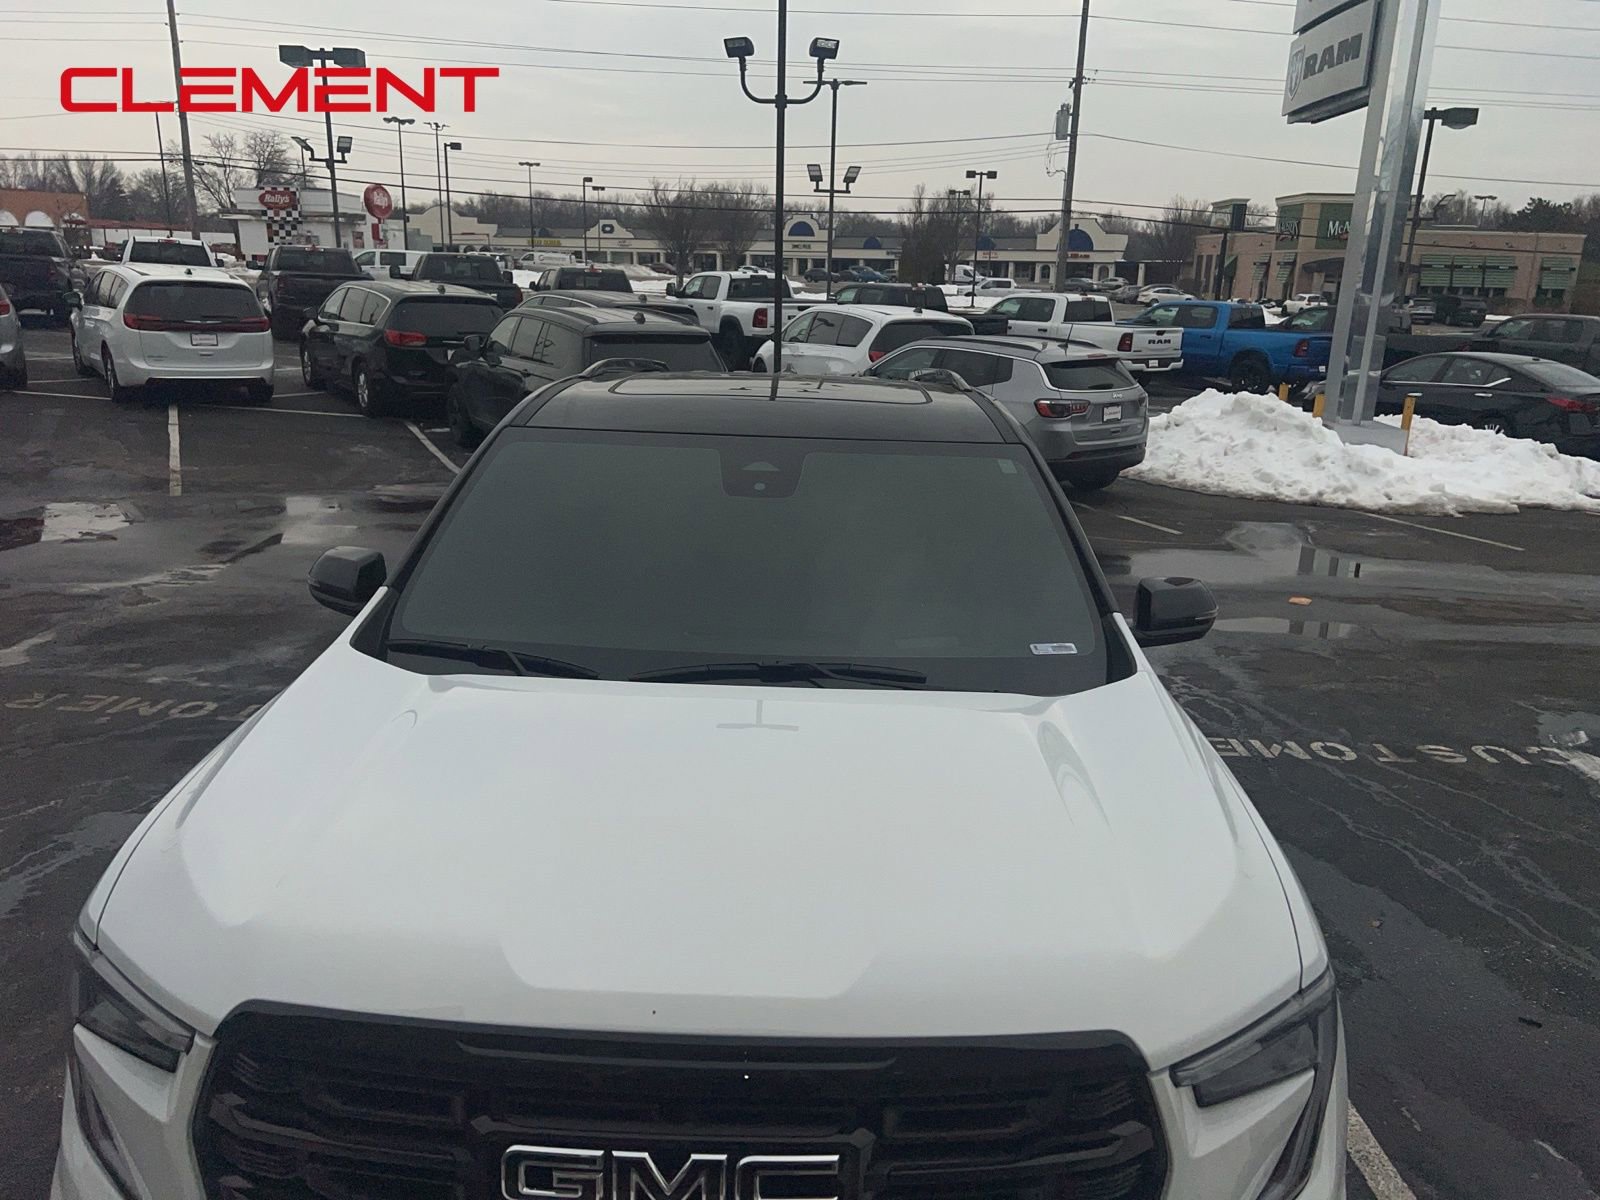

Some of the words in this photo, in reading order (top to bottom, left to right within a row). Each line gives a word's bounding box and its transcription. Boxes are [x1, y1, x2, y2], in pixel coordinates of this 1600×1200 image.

[1303, 32, 1363, 80] RAM
[264, 194, 290, 203] Rally's
[1327, 220, 1351, 238] McA
[4, 693, 262, 721] TOMER
[1208, 737, 1571, 765] CUSTOME
[501, 1144, 840, 1200] GMC
